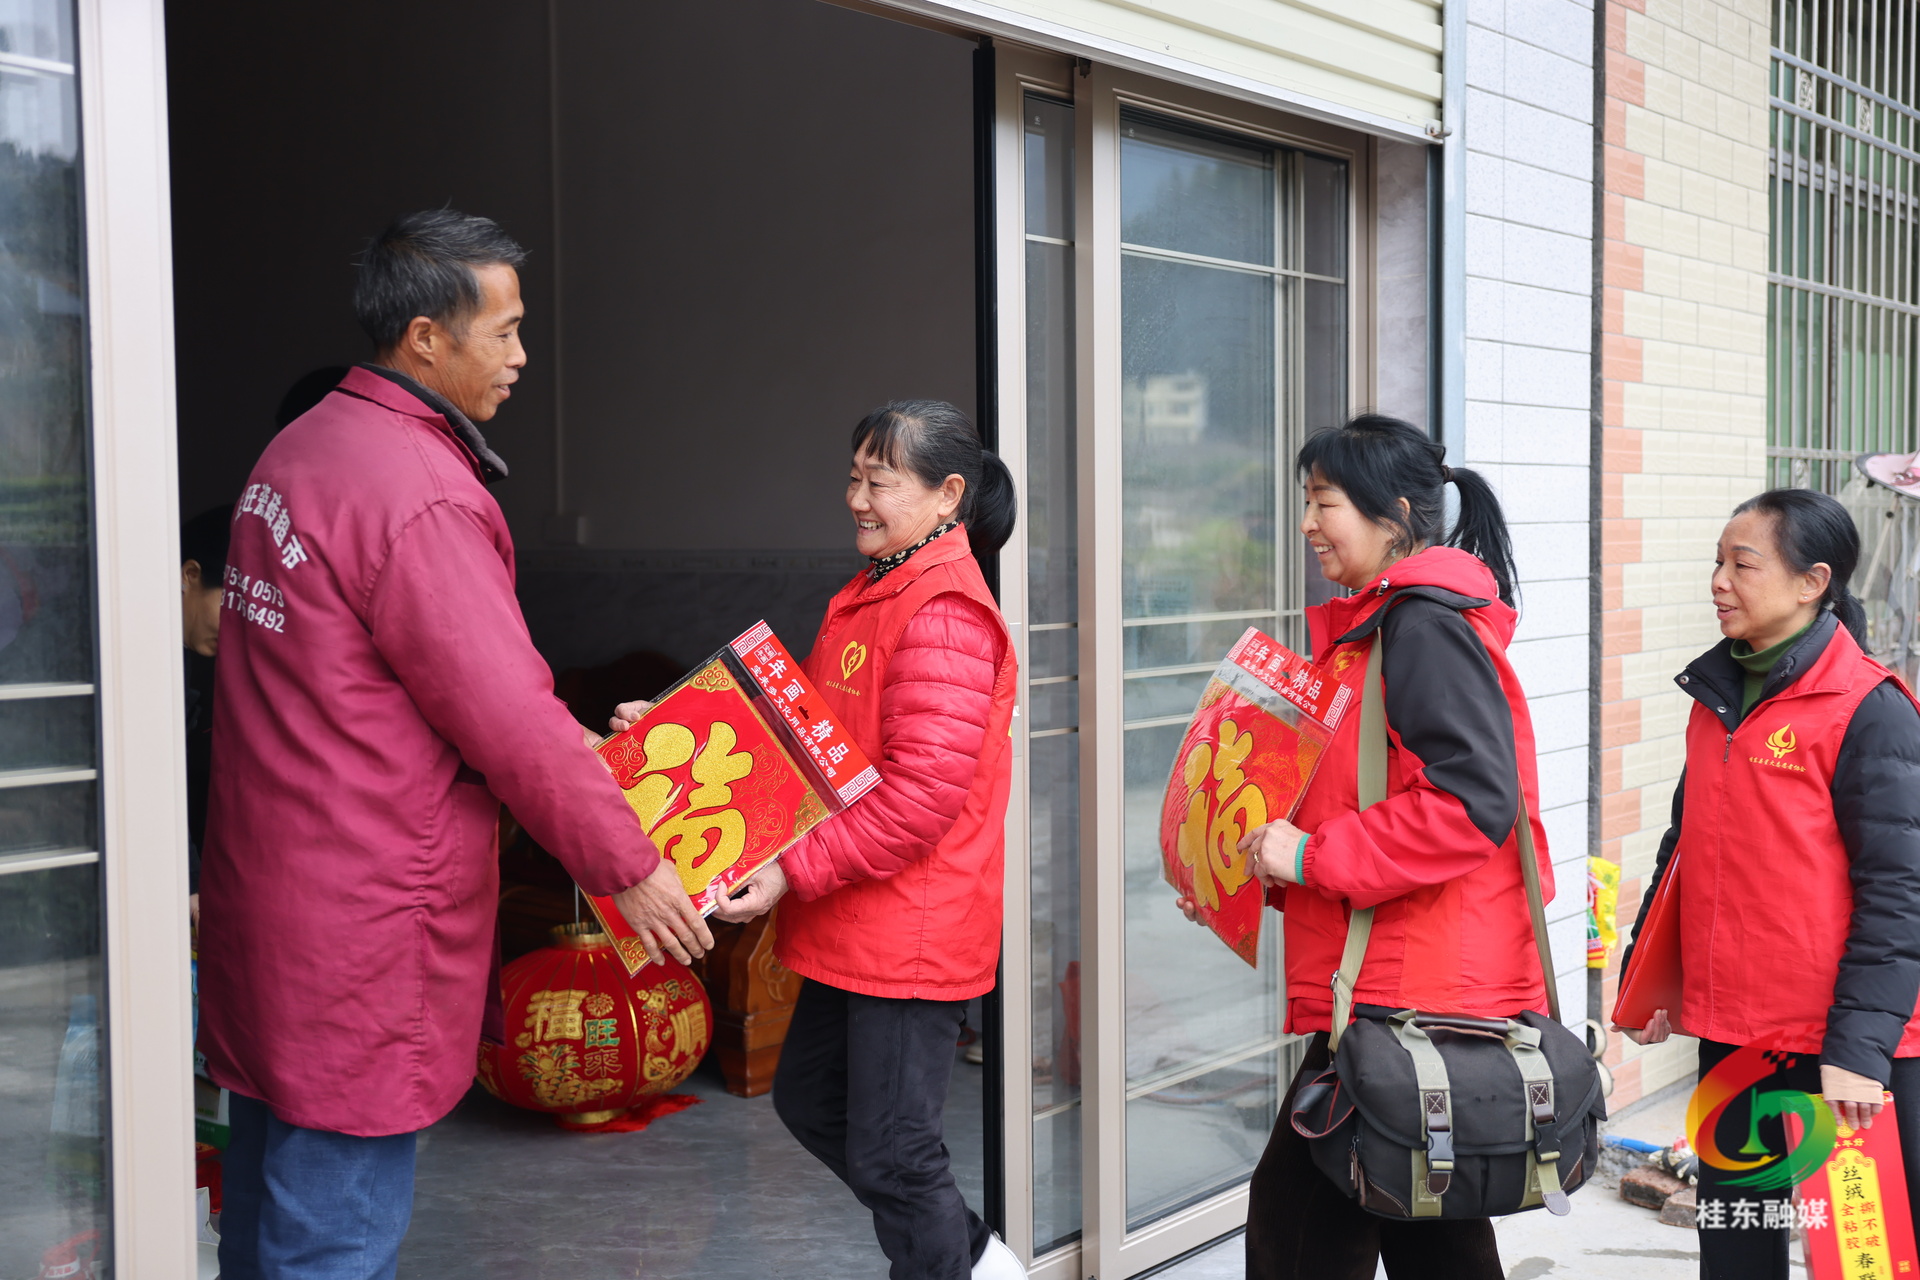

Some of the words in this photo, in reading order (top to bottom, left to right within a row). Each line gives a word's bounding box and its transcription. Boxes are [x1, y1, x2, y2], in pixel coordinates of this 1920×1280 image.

[252, 580, 285, 608] 0573
[1292, 668, 1323, 701] 精品
[811, 719, 850, 765] 精品
[524, 989, 589, 1042] 福
[1842, 1165, 1865, 1201] 丝绒
